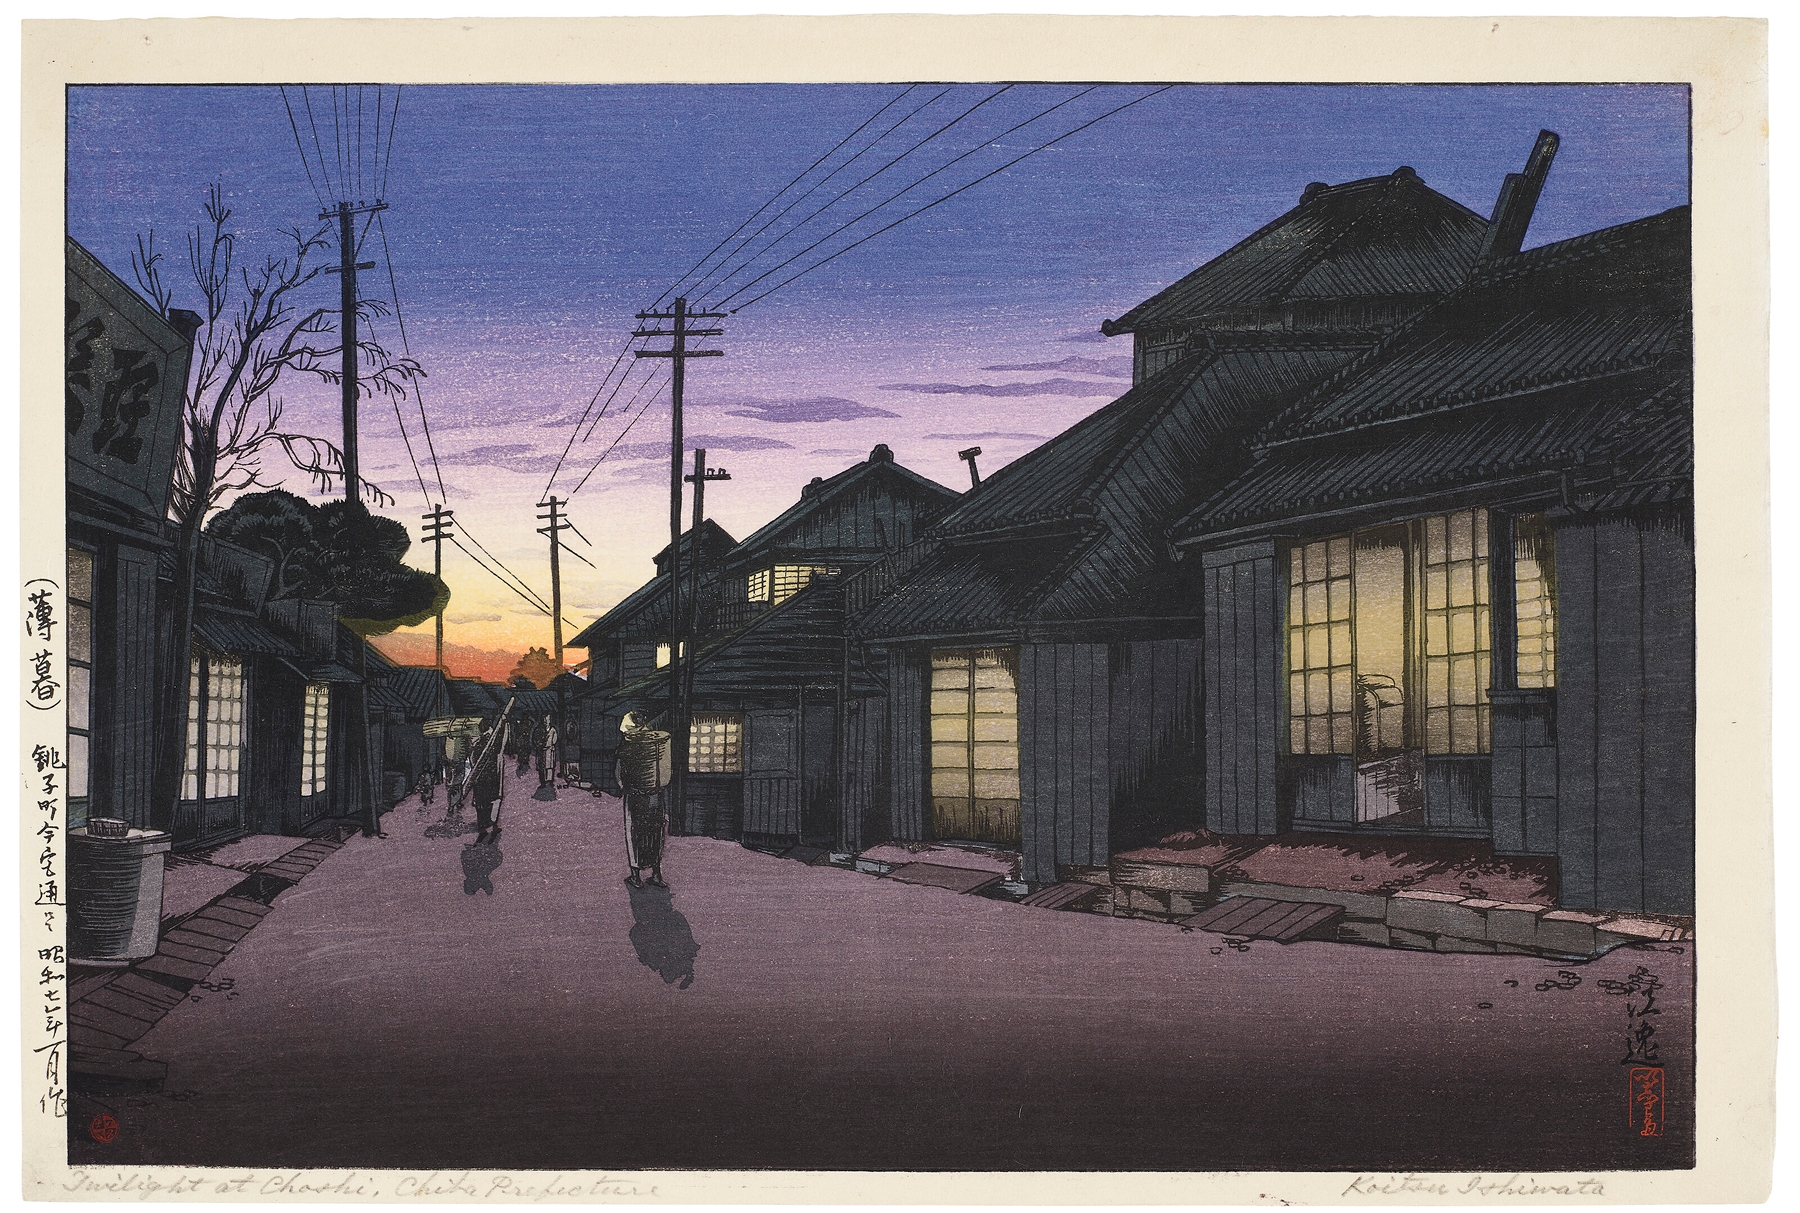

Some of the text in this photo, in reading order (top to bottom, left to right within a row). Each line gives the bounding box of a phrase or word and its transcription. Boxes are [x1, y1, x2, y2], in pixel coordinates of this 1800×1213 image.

[61, 1170, 208, 1200] Twilight
[214, 1174, 255, 1194] at
[485, 1174, 664, 1202] Prefecture
